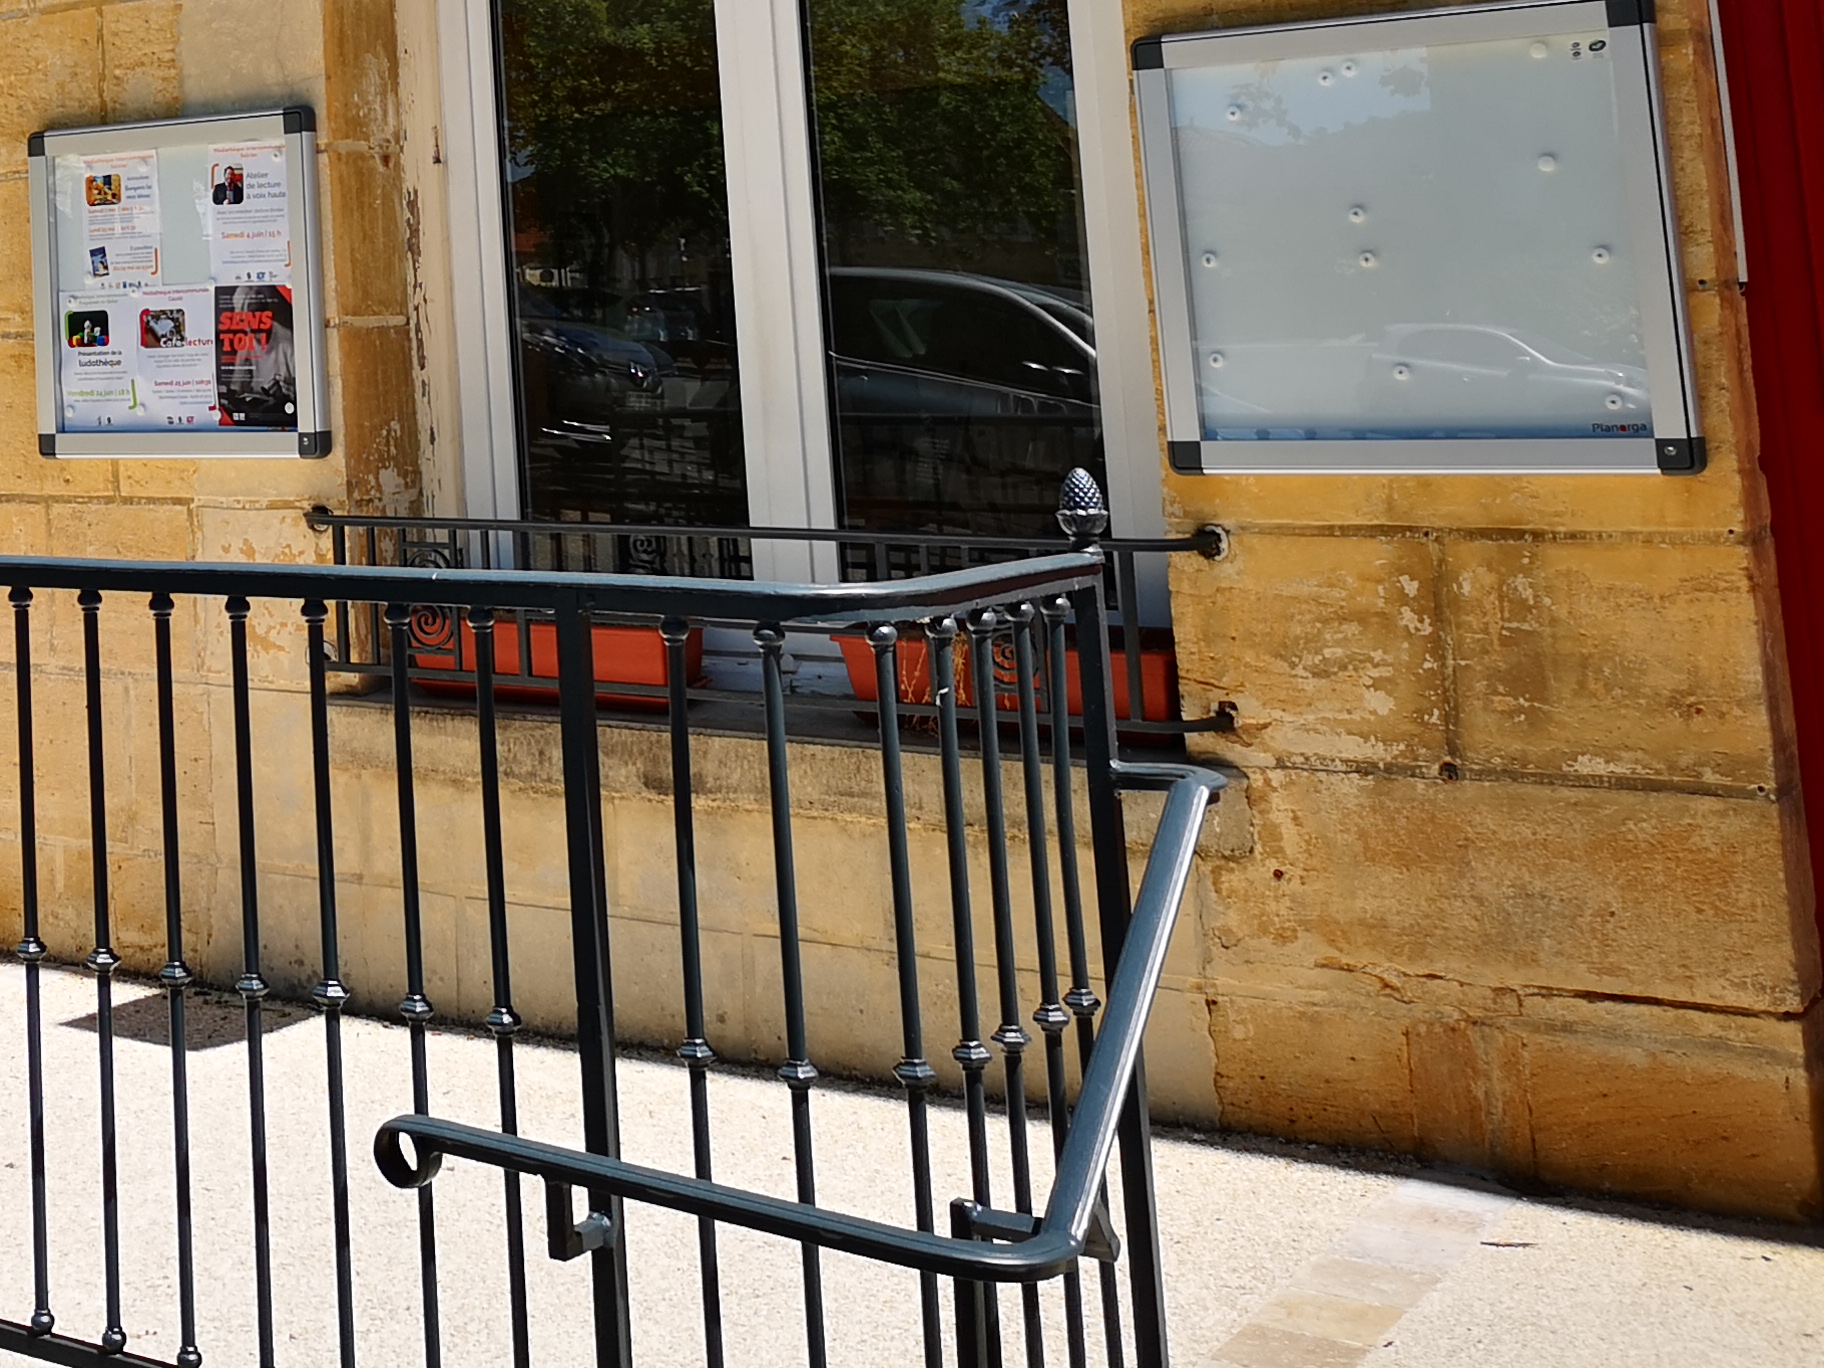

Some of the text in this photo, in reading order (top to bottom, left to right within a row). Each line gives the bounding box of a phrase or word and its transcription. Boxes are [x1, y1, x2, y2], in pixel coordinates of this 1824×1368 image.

[246, 181, 282, 190] de lecture
[252, 192, 266, 200] voix
[221, 231, 245, 239] Samedi
[218, 311, 273, 330] SENS
[220, 333, 256, 352] TOI
[78, 358, 122, 368] ludothèque
